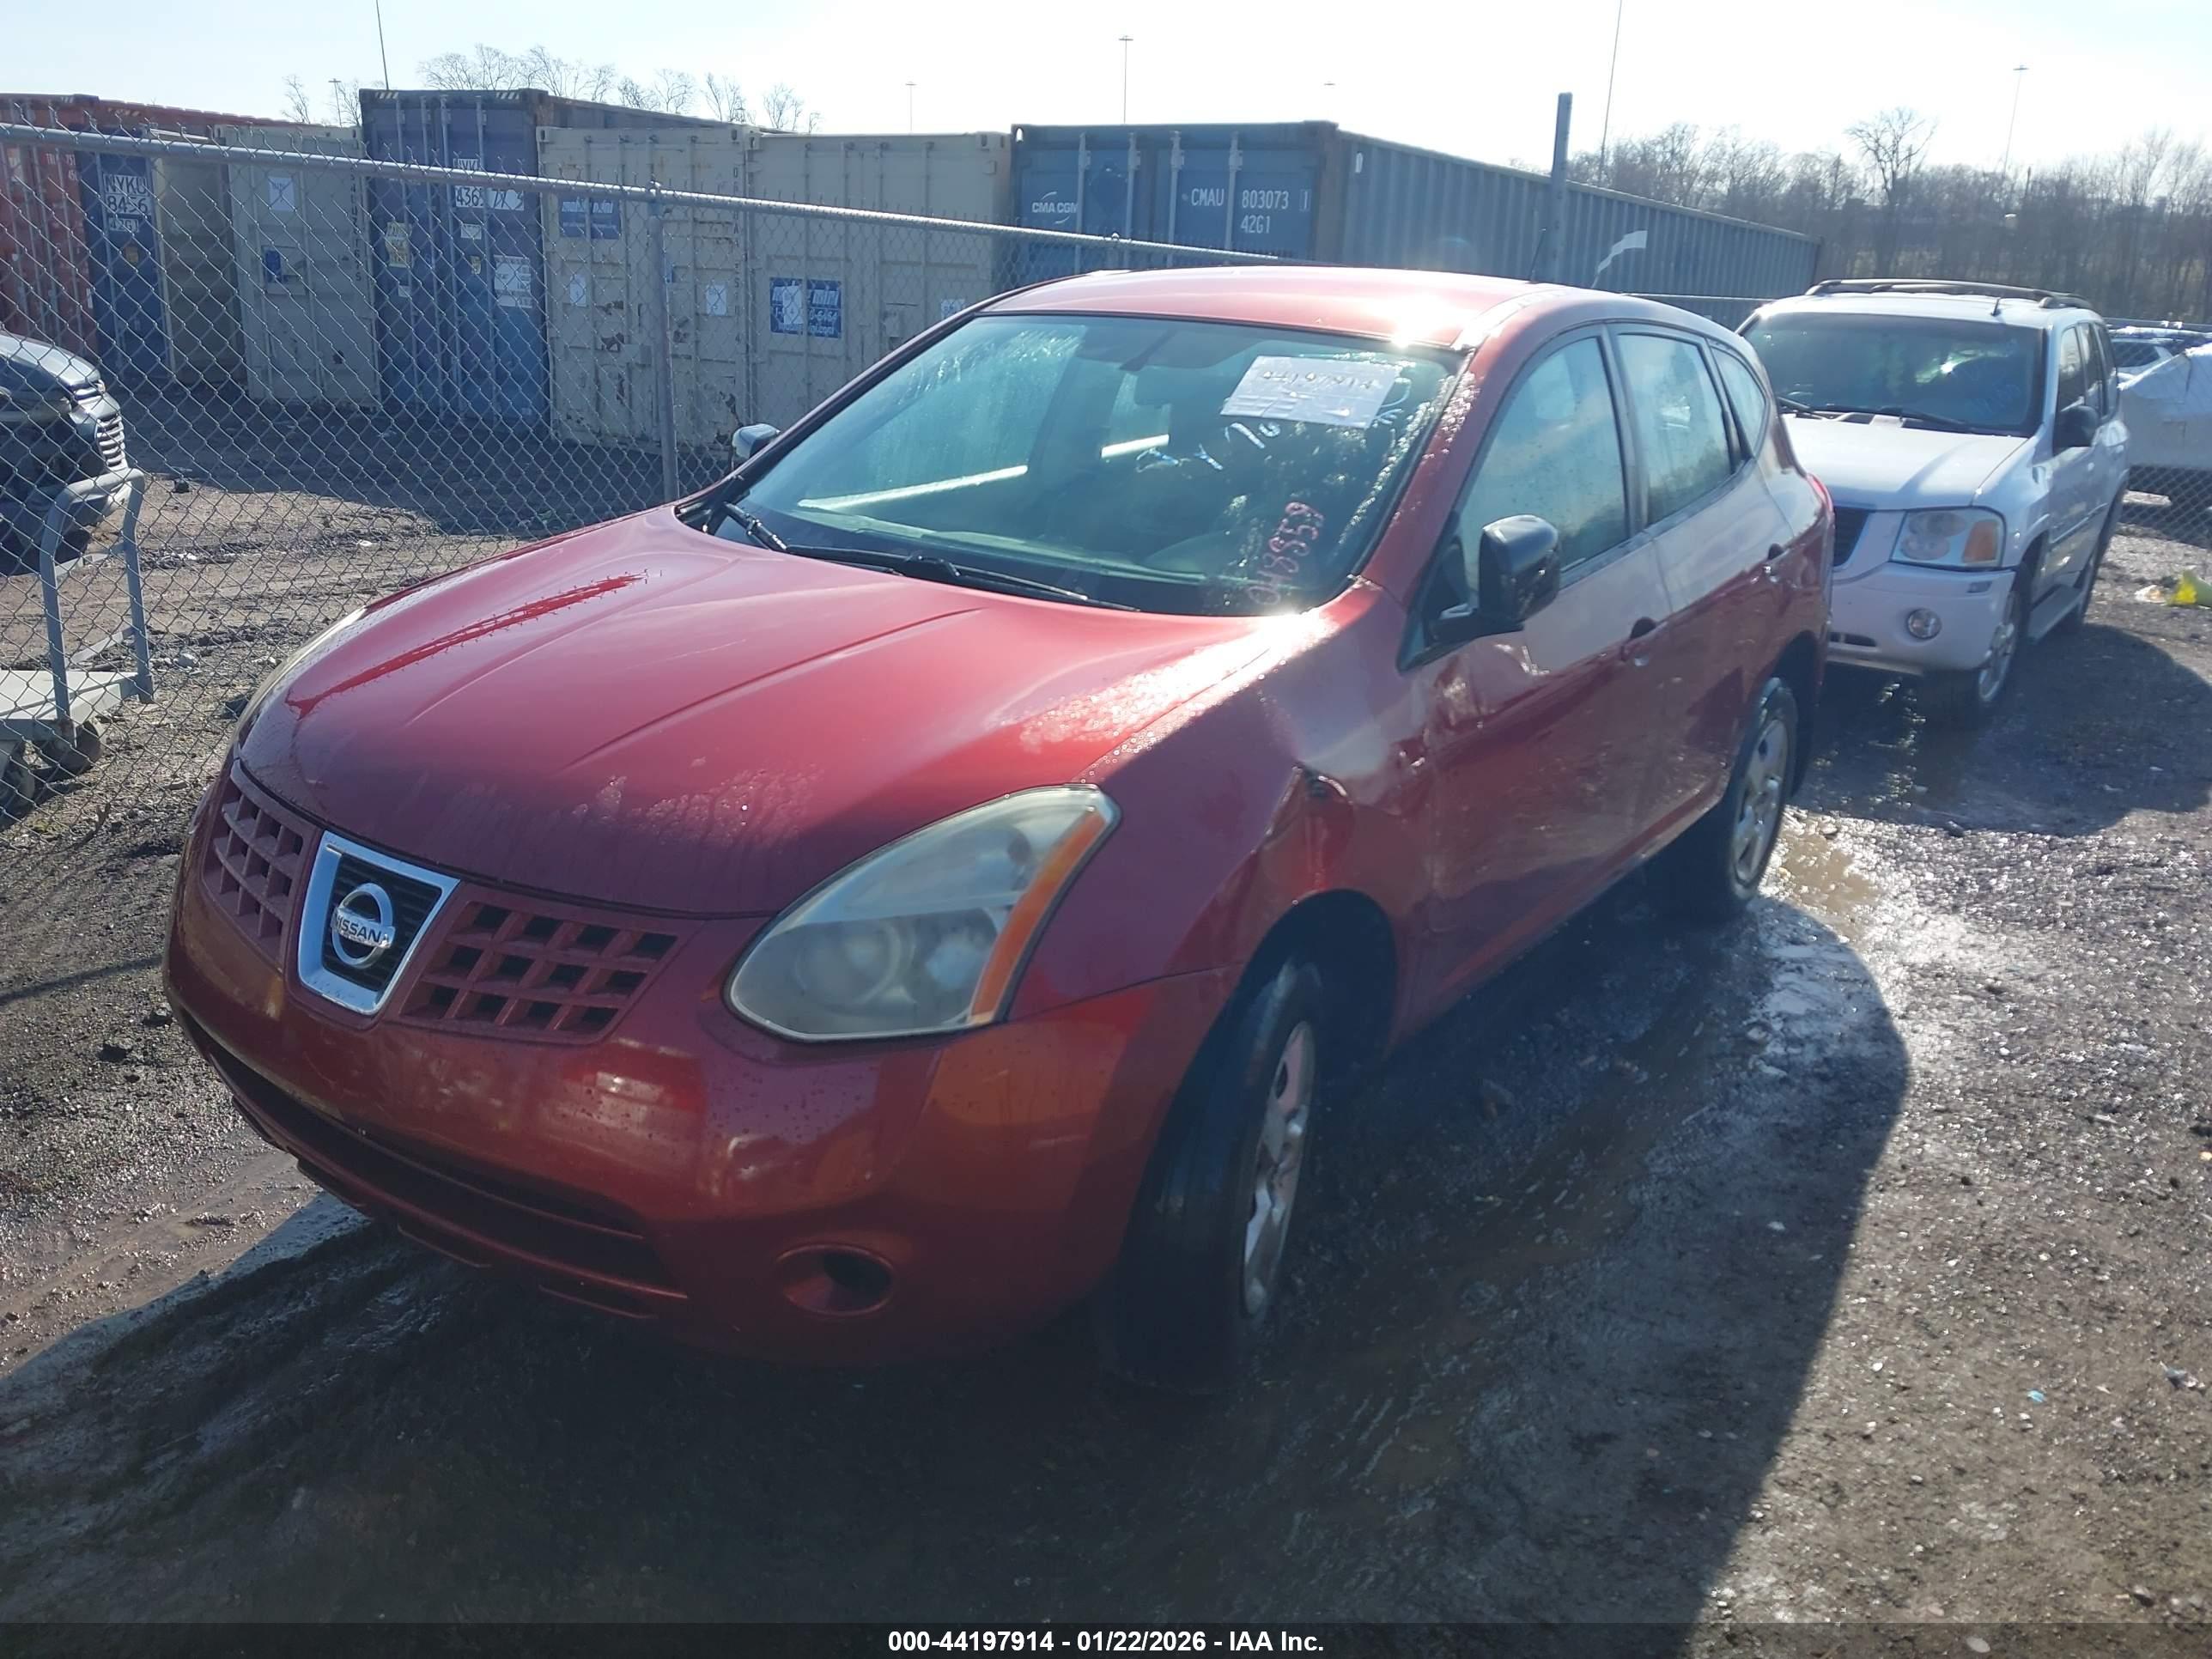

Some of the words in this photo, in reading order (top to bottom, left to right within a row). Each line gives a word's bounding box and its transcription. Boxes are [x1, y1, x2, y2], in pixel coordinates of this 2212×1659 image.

[106, 175, 147, 194] NYKU
[107, 196, 148, 214] 8456
[1032, 203, 1055, 213] CMA
[1191, 188, 1224, 206] CMAU
[1242, 189, 1289, 209] 803073
[1241, 215, 1271, 234] 42G1
[334, 914, 382, 943] NISSAN
